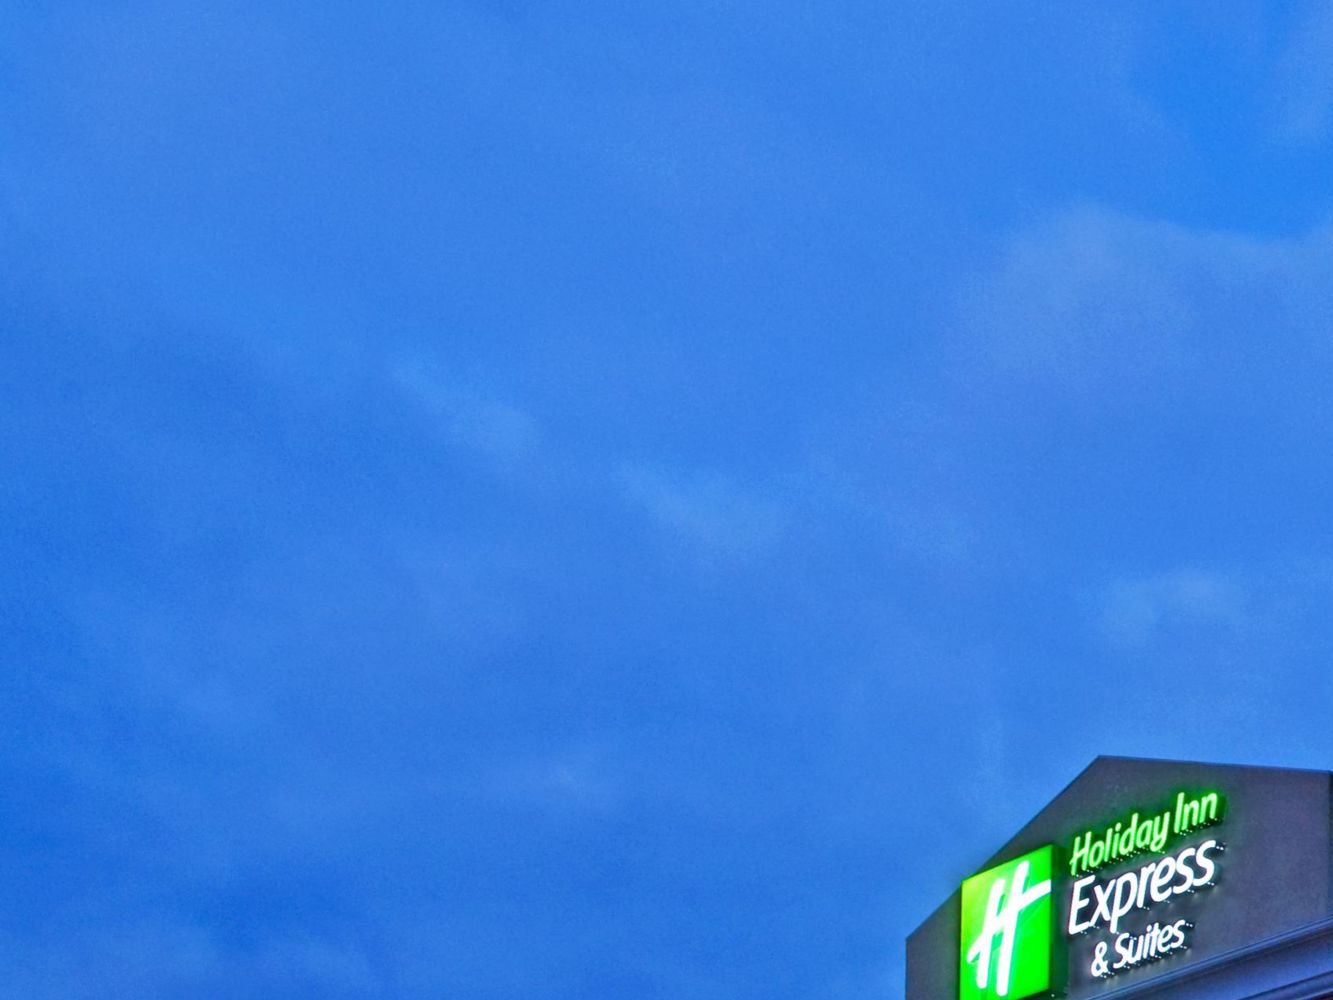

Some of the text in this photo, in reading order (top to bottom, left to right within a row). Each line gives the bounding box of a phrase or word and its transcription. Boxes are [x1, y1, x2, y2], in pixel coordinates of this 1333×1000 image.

[1069, 792, 1218, 876] Holiday Inn
[1067, 839, 1217, 935] Express
[1090, 919, 1185, 977] & Suites
